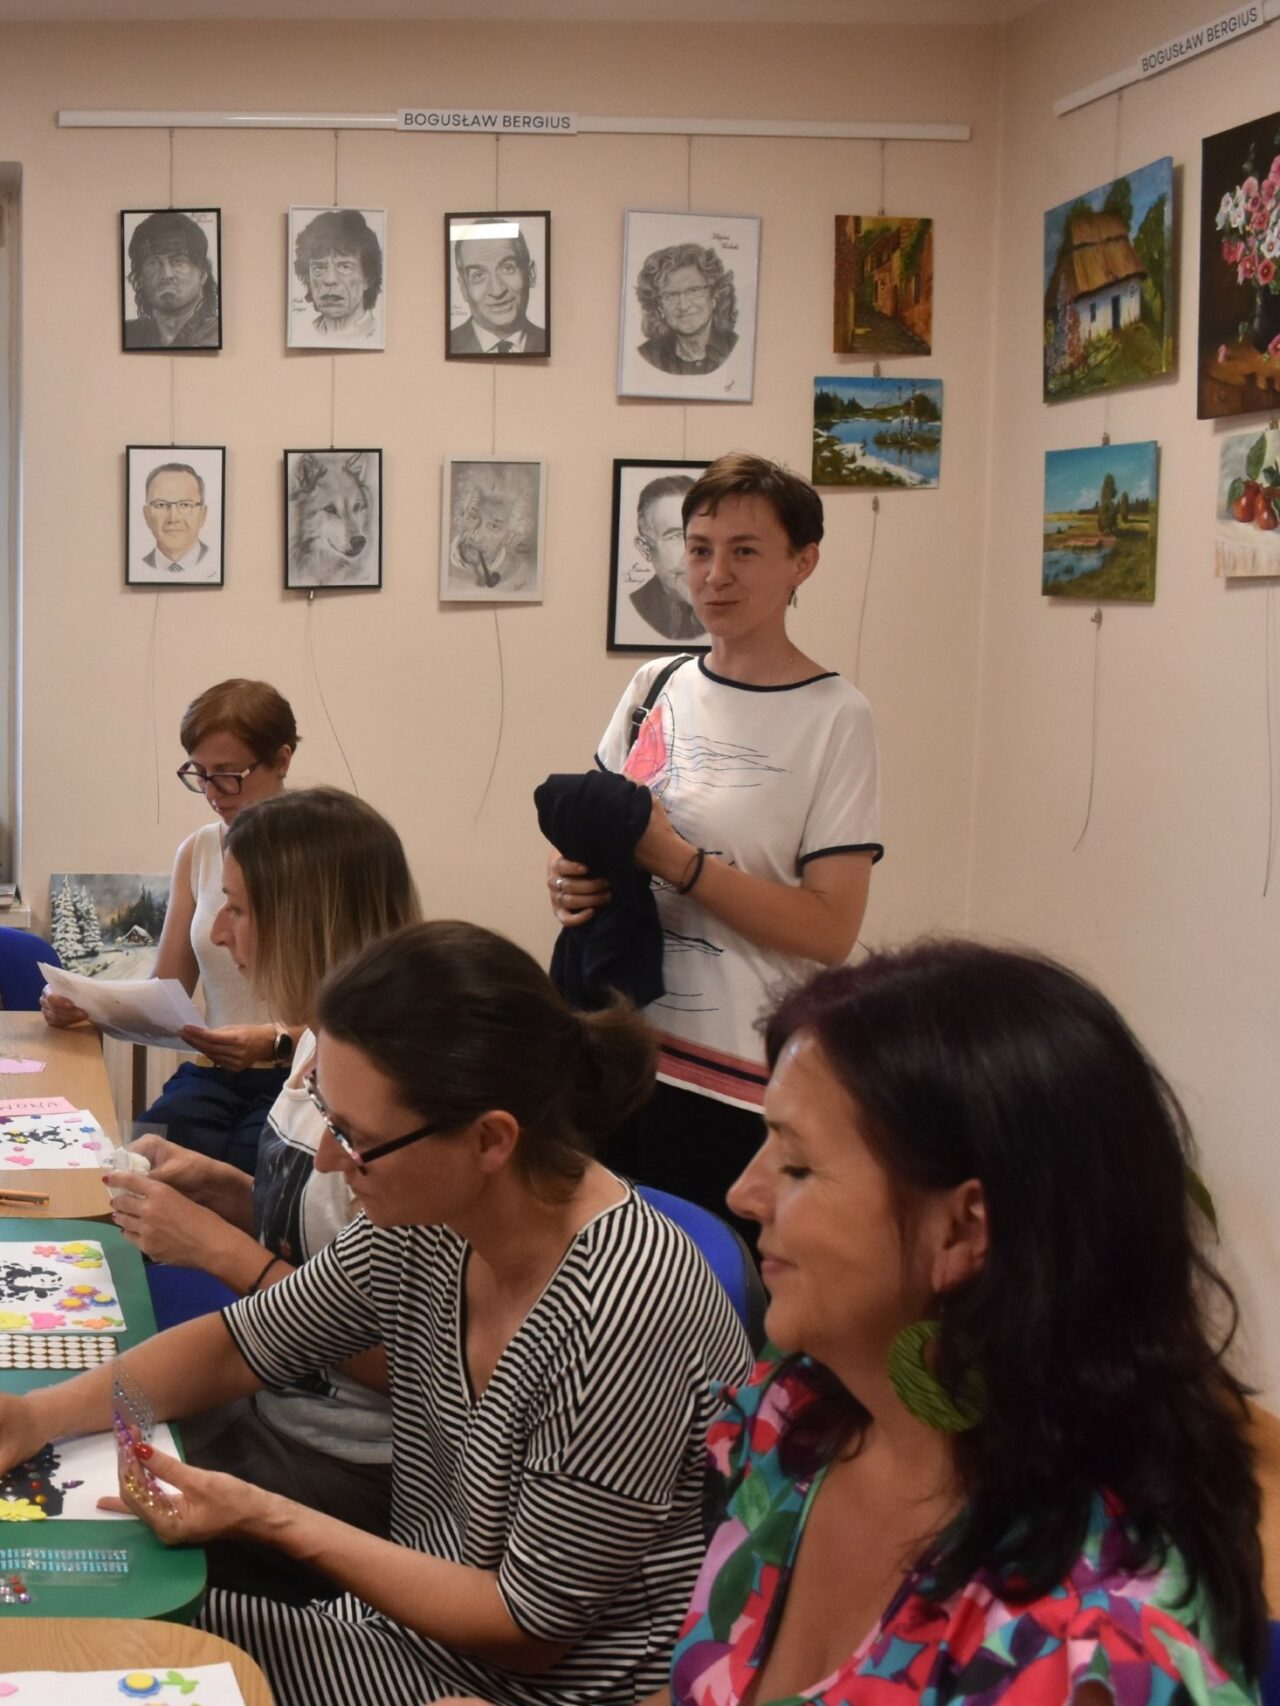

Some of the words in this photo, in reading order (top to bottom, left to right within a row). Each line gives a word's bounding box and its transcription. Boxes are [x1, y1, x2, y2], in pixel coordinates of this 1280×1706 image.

[1141, 31, 1204, 72] BOGUSŁAW
[1205, 6, 1258, 43] BERGIUS
[404, 112, 498, 128] BOGUSŁAW
[502, 114, 571, 129] BERGIUS
